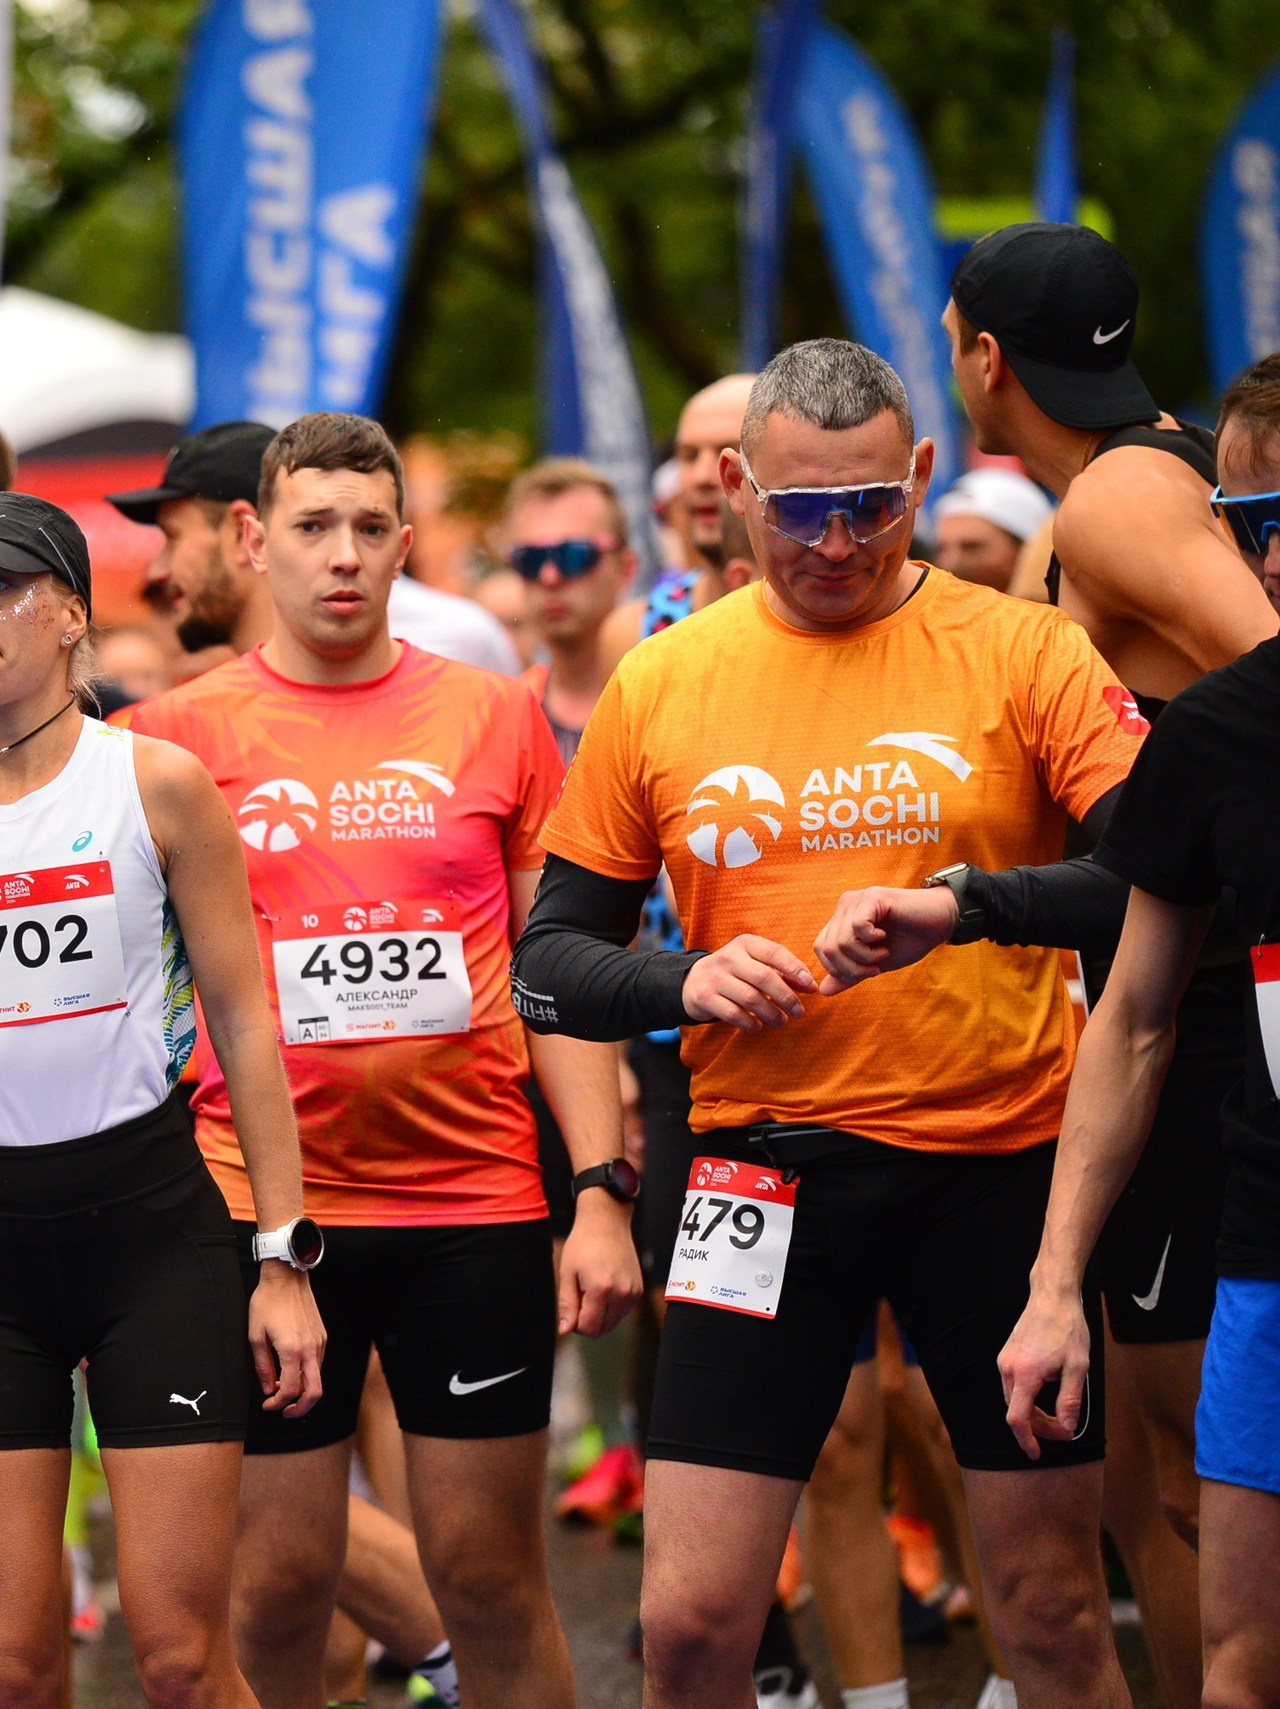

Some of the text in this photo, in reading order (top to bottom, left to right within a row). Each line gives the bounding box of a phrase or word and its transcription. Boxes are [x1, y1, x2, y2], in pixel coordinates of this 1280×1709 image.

[799, 760, 919, 797] ANTA
[328, 779, 419, 803] ANTA
[328, 801, 436, 827] SOCHI
[799, 791, 940, 831] SOCHI
[330, 825, 436, 842] MARATHON
[801, 826, 940, 853] MARATHON
[3, 879, 26, 889] ANTA
[4, 885, 30, 896] SOCHI
[65, 881, 80, 890] ANTA
[301, 913, 319, 929] 10
[300, 937, 447, 986] 4932
[63, 993, 90, 1002] ВЫСШАЯ
[63, 999, 80, 1007] ЛИГА
[336, 988, 418, 1004] АЛЕКСАНДР
[681, 1196, 765, 1251] 479
[678, 1248, 710, 1261] РАДИК
